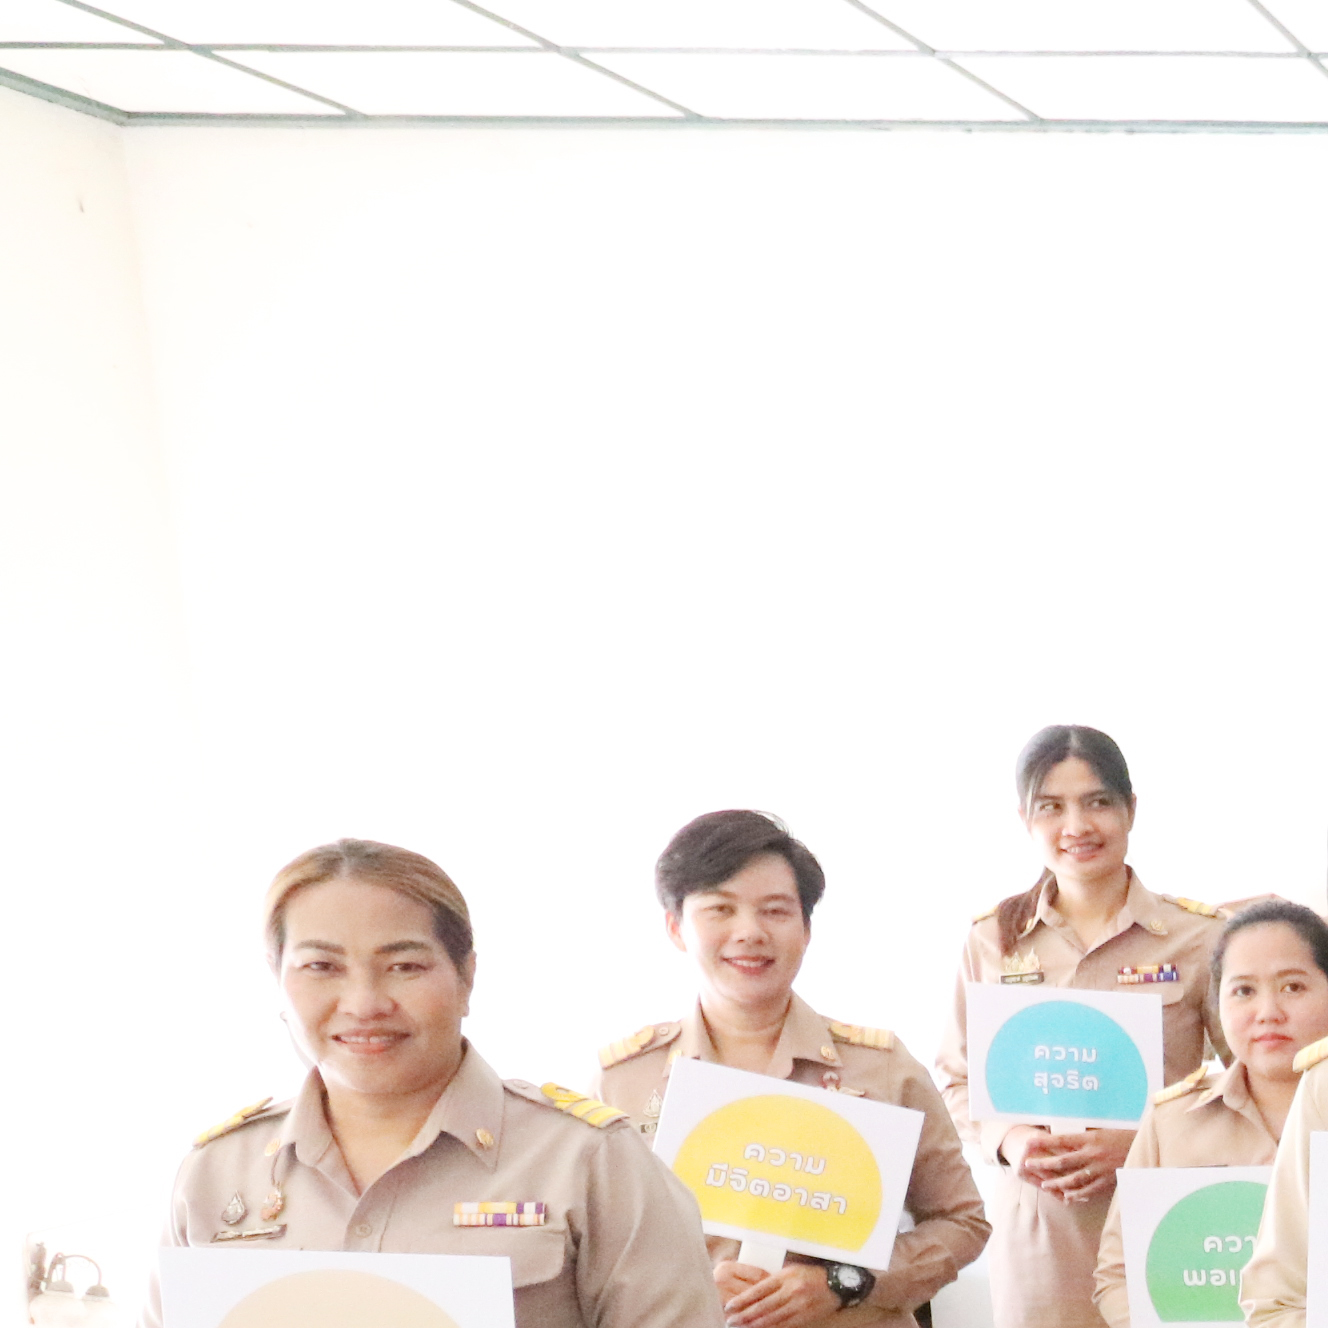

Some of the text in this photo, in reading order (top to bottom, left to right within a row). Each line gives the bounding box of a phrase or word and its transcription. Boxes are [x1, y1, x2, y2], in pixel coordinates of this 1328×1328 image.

[1033, 1044, 1098, 1063] ความ
[1033, 1068, 1099, 1095] สุจริต
[742, 1142, 827, 1176] ความ
[704, 1161, 848, 1215] มีจิตอาสา
[1203, 1235, 1258, 1254] ควา
